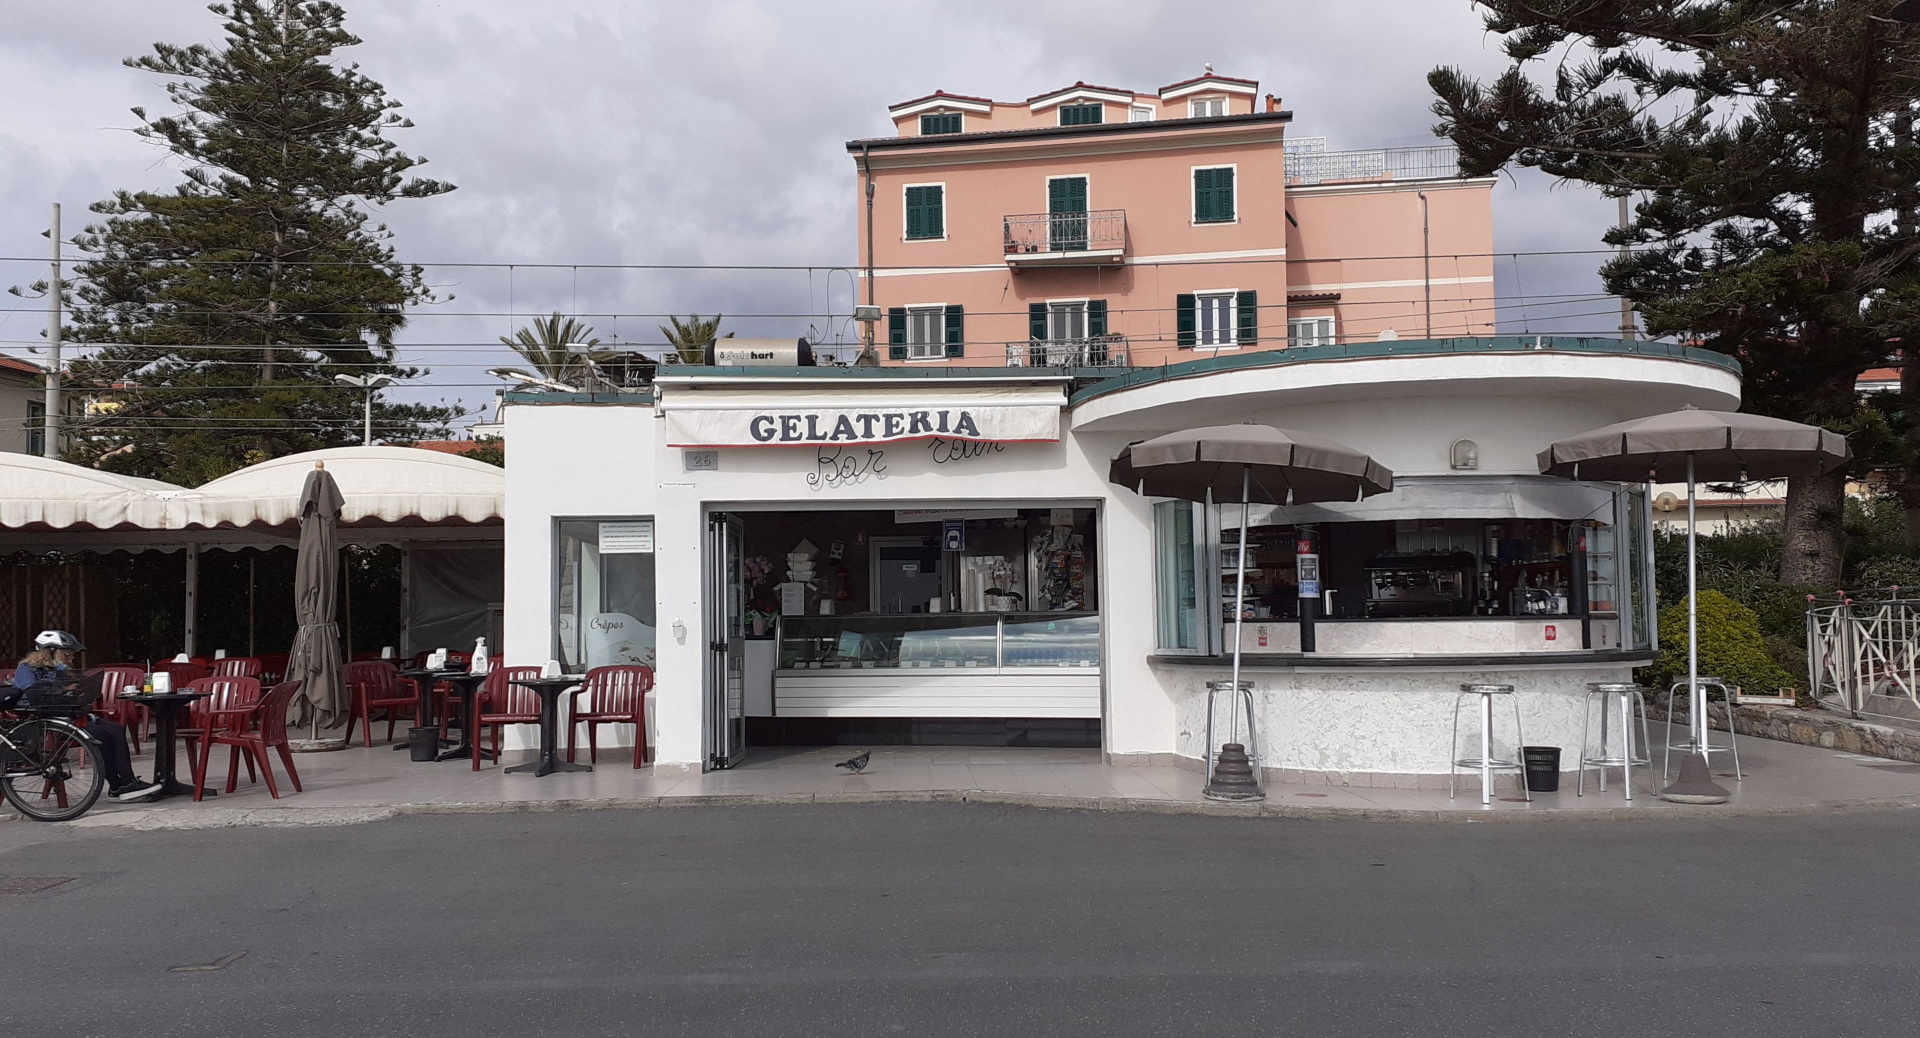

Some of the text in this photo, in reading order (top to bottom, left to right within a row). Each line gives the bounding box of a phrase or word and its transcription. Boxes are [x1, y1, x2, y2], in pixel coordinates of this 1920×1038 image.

[749, 410, 981, 442] GELATERIA
[693, 455, 711, 467] 26
[590, 617, 624, 634] Crêpes
